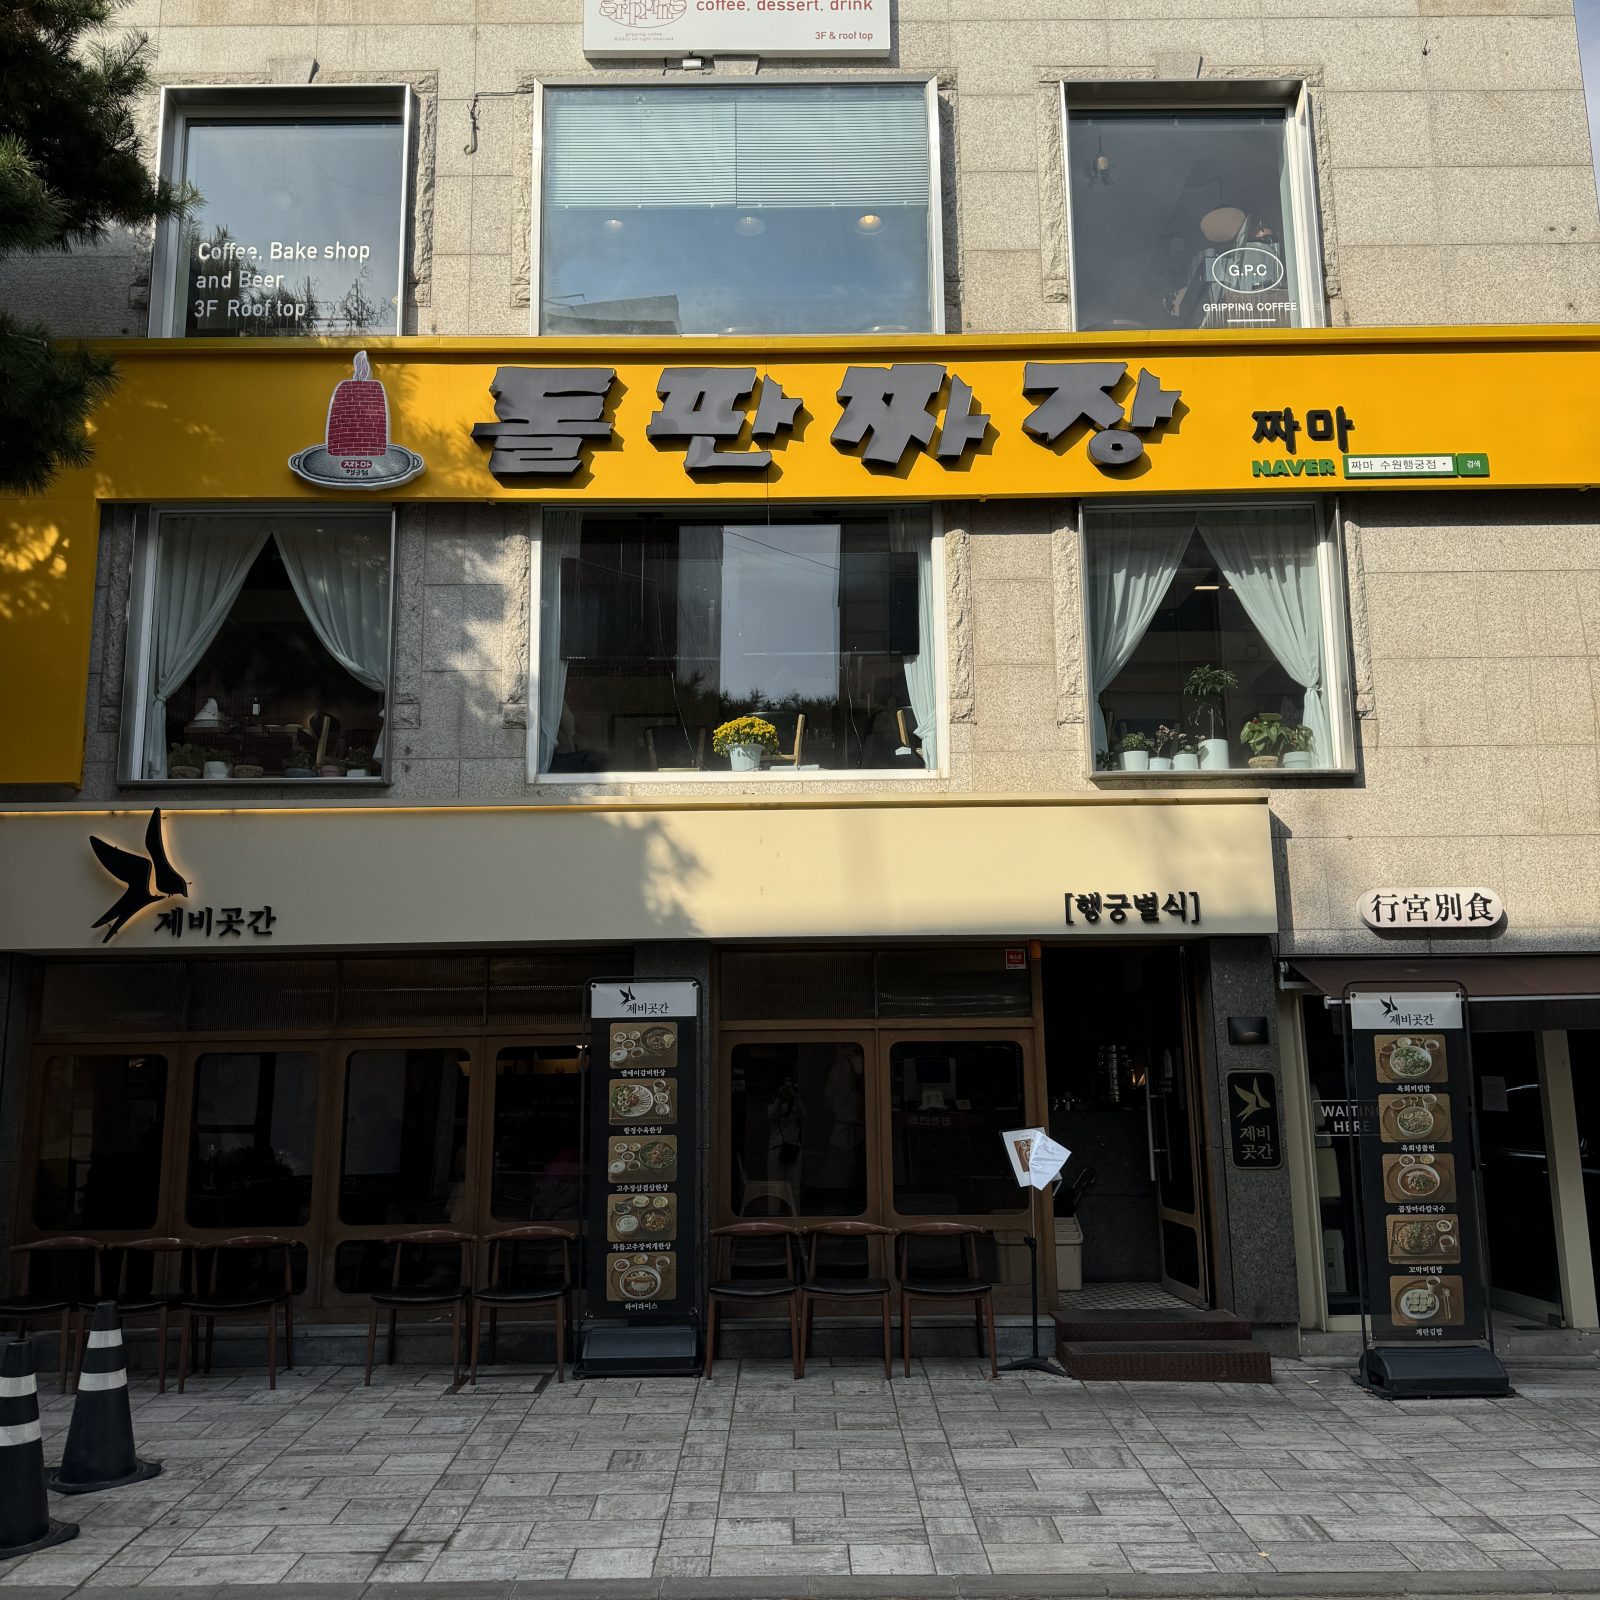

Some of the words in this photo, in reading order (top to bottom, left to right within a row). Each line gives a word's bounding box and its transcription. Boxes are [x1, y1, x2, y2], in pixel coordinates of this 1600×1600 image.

[815, 31, 827, 40] 3F
[829, 32, 836, 40] &
[838, 31, 858, 40] roof
[858, 32, 873, 42] top
[270, 241, 318, 260] Bake
[323, 240, 370, 263] shop
[1228, 264, 1268, 277] G.P.C
[195, 270, 232, 289] and
[238, 270, 285, 289] Beer
[193, 299, 219, 318] 3F
[227, 298, 271, 318] Roof
[276, 300, 306, 321] top
[1202, 303, 1253, 312] GRIPPING
[1256, 302, 1297, 311] COFFEE
[470, 361, 1183, 478] 돌판짜장
[1251, 405, 1355, 455] 짜마
[1252, 458, 1336, 477] NAVER
[1350, 459, 1374, 471] 짜마
[1379, 458, 1438, 471] 수원행궁점
[1466, 459, 1481, 470] 검색
[1370, 892, 1495, 923] 行宮別食
[154, 905, 277, 938] 제비곳간
[626, 1001, 670, 1015] 제비곳간
[1389, 1013, 1435, 1026] 제비곳간
[1396, 1084, 1432, 1093] 육회비빔밥
[1320, 1105, 1376, 1118] WAITIN
[1239, 1125, 1271, 1142] 제비
[1240, 1143, 1274, 1160] 곳간
[1408, 1265, 1444, 1275] 꼬막비빔밥
[624, 1302, 659, 1312] 하이라이스
[1415, 1327, 1444, 1337] 계란김밥
